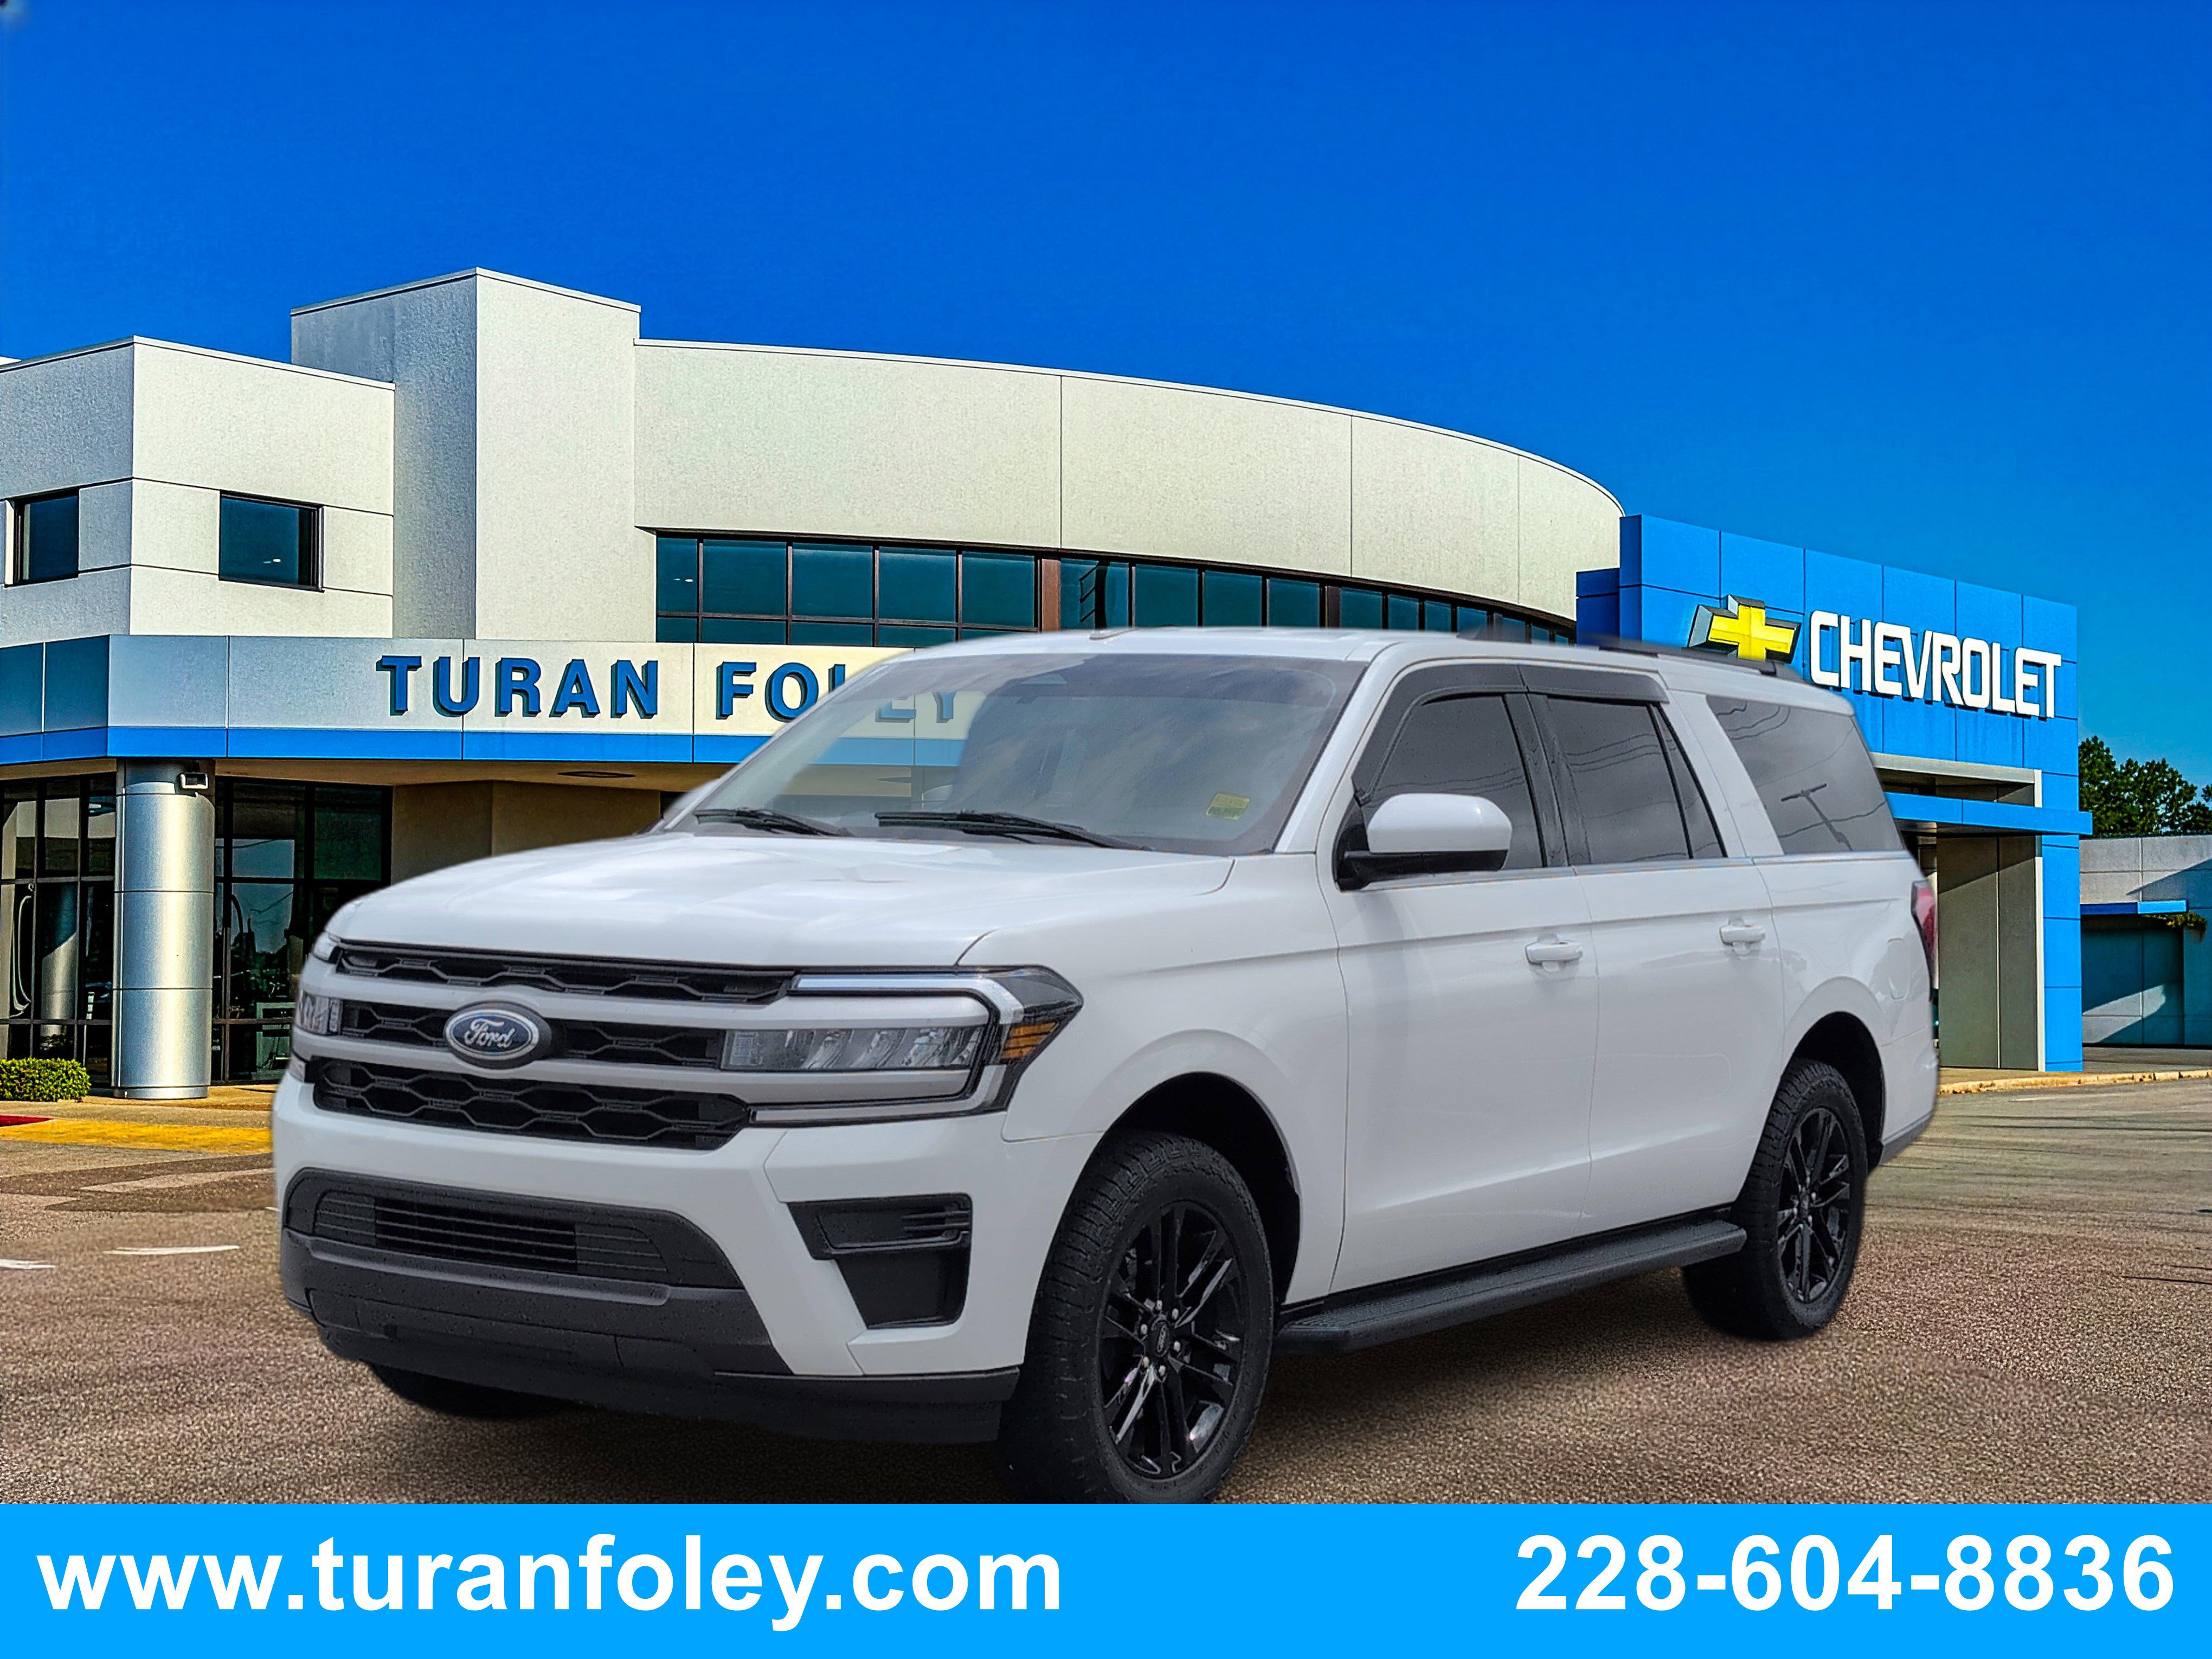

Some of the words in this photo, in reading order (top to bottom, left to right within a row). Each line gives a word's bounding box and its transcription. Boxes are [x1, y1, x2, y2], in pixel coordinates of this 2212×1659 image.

[376, 655, 658, 719] TURAN
[716, 661, 956, 723] FOY
[1810, 610, 2062, 719] CHEVROLET
[464, 1018, 516, 1049] Ford
